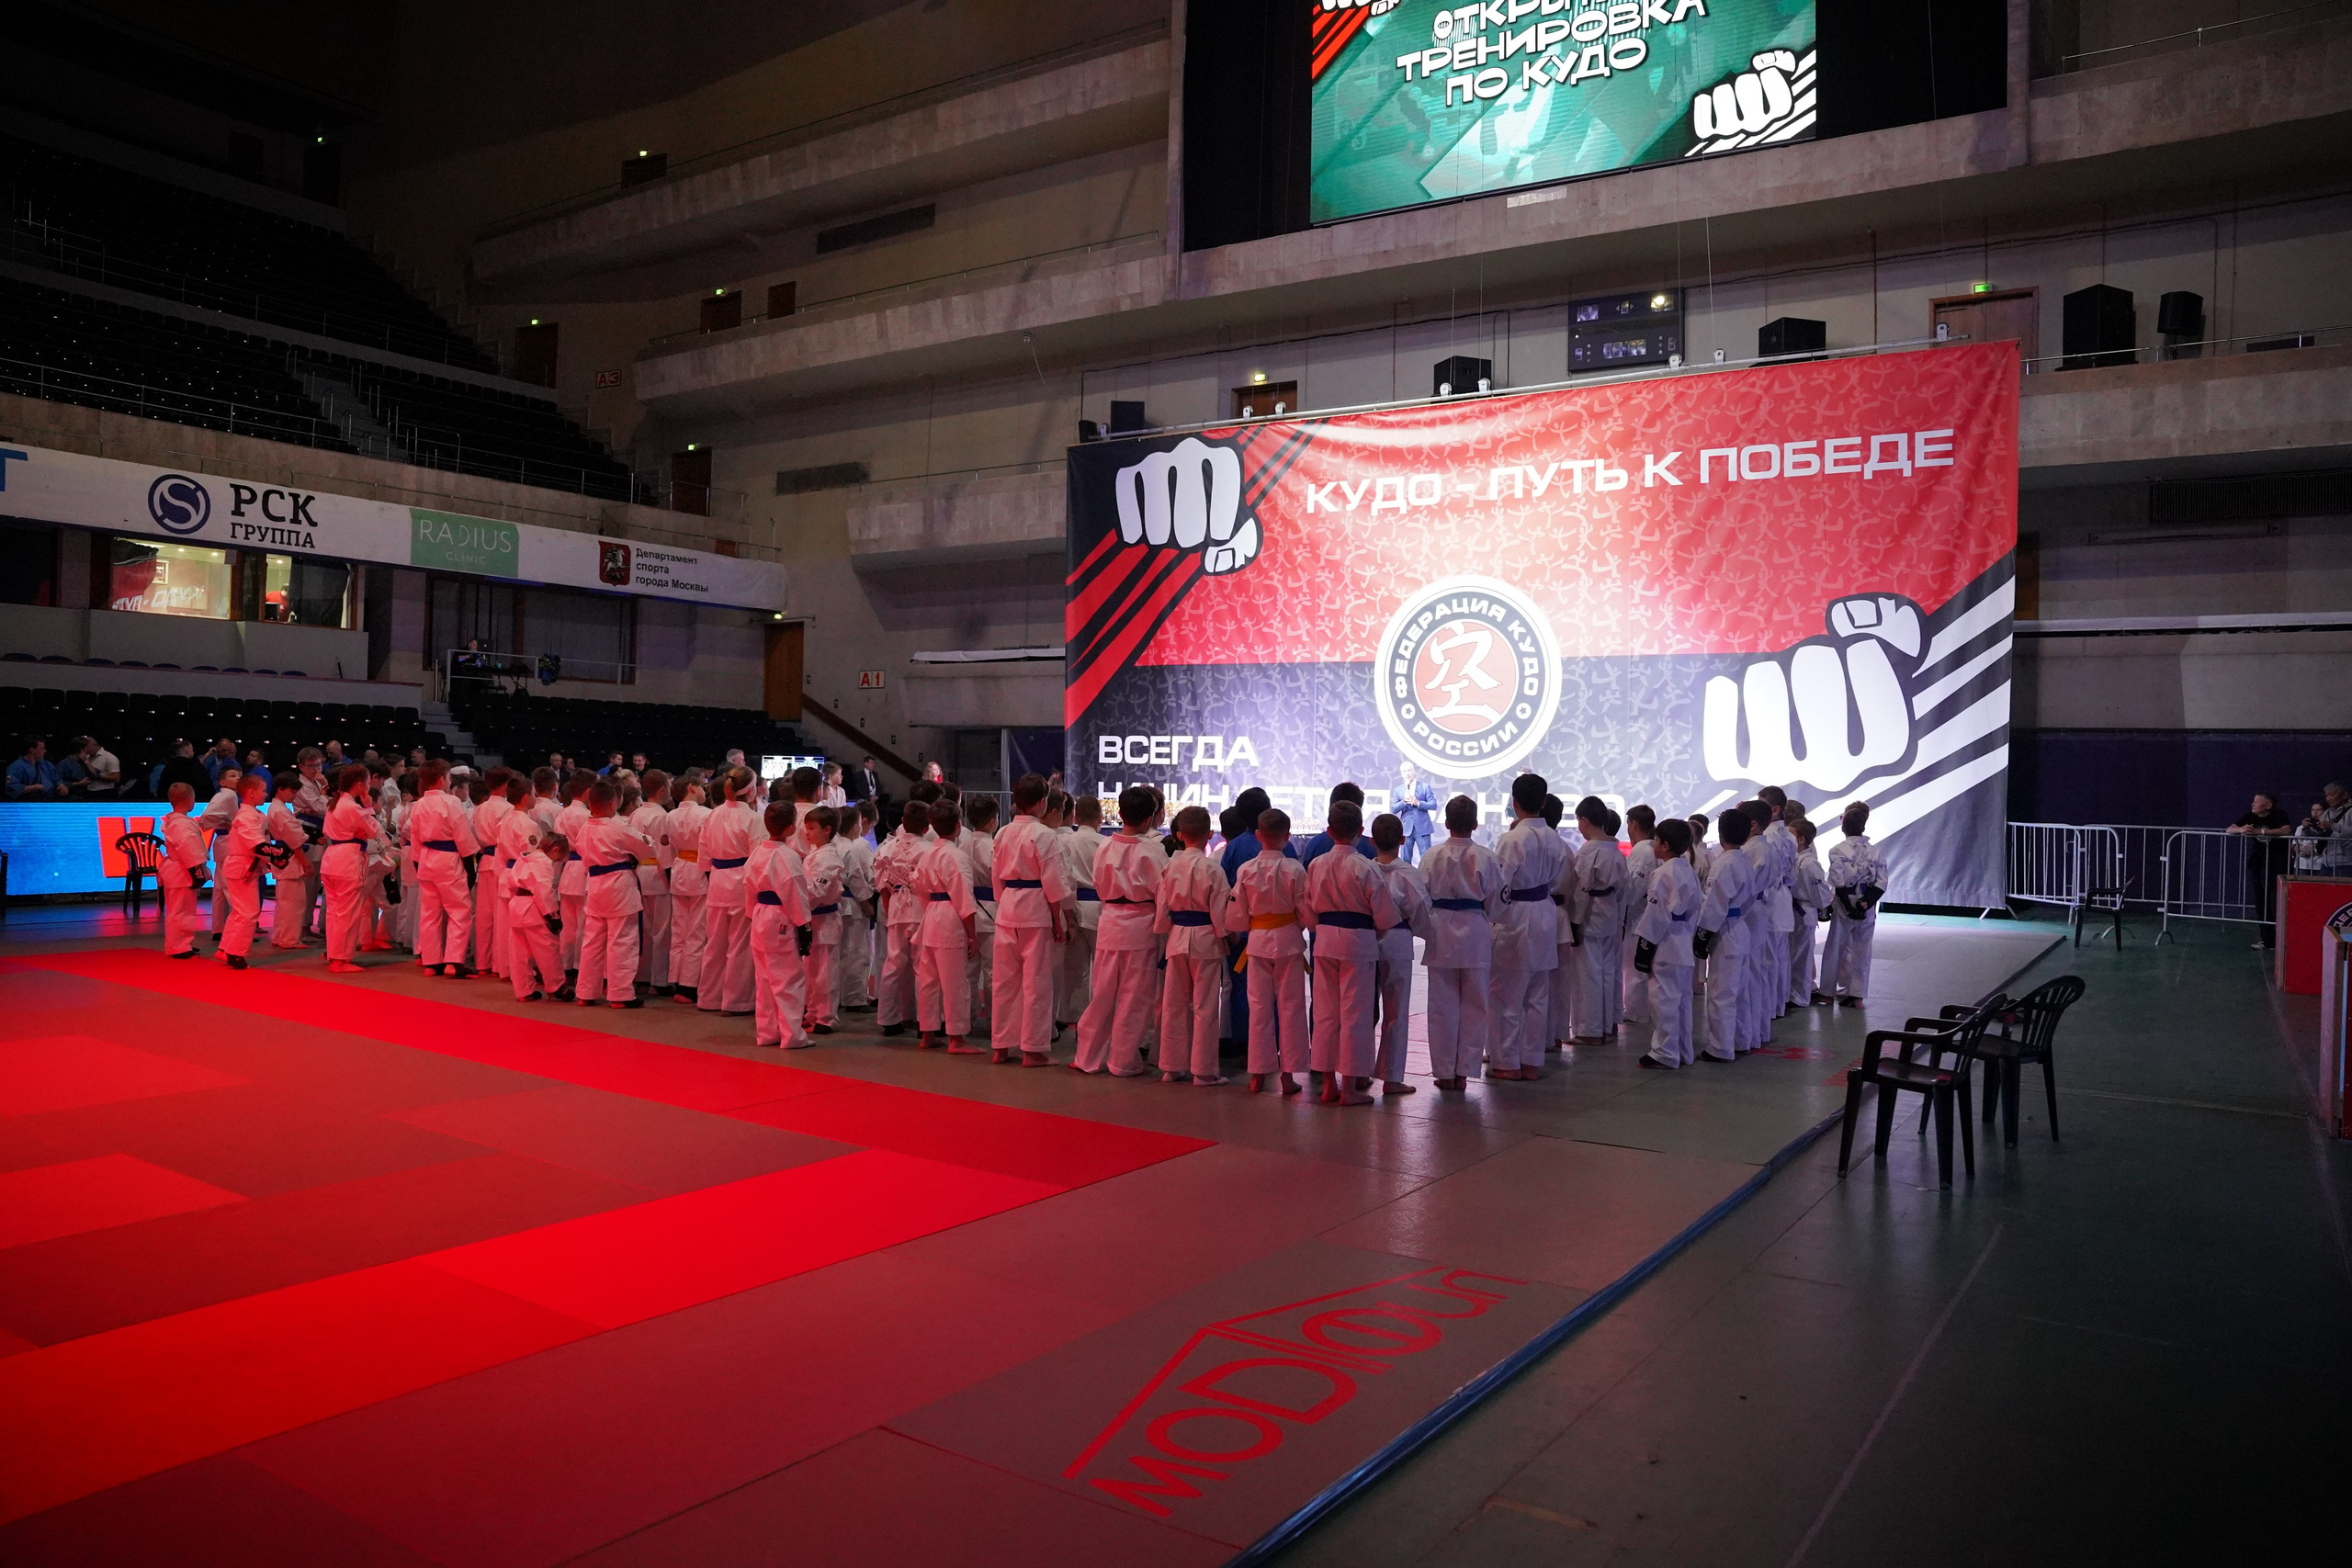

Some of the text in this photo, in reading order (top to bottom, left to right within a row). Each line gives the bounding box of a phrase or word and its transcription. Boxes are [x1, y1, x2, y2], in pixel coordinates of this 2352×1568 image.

[1433, 0, 1608, 39] ОТКРЫ
[1396, 0, 1706, 81] ТРЕНИРОВКА
[1446, 38, 1647, 106] ПО КУДО
[1306, 474, 1443, 516] КУДО
[1489, 457, 1629, 501] ПУТЬ
[1644, 451, 1684, 488] К
[1700, 429, 1954, 484] ПОБЕДЕ
[229, 483, 319, 527] РСК
[230, 522, 316, 549] ГРУППА
[420, 519, 512, 553] RADIUS
[446, 551, 487, 565] CLINIC
[636, 547, 698, 565] Департамент
[636, 562, 670, 574] спорта
[636, 576, 708, 592] города Москвы
[1395, 597, 1540, 698] ФЕДЕРАЦИЯ КУДО
[1099, 736, 1260, 773] ВСЕГДА
[1412, 721, 1519, 757] РОССИИ
